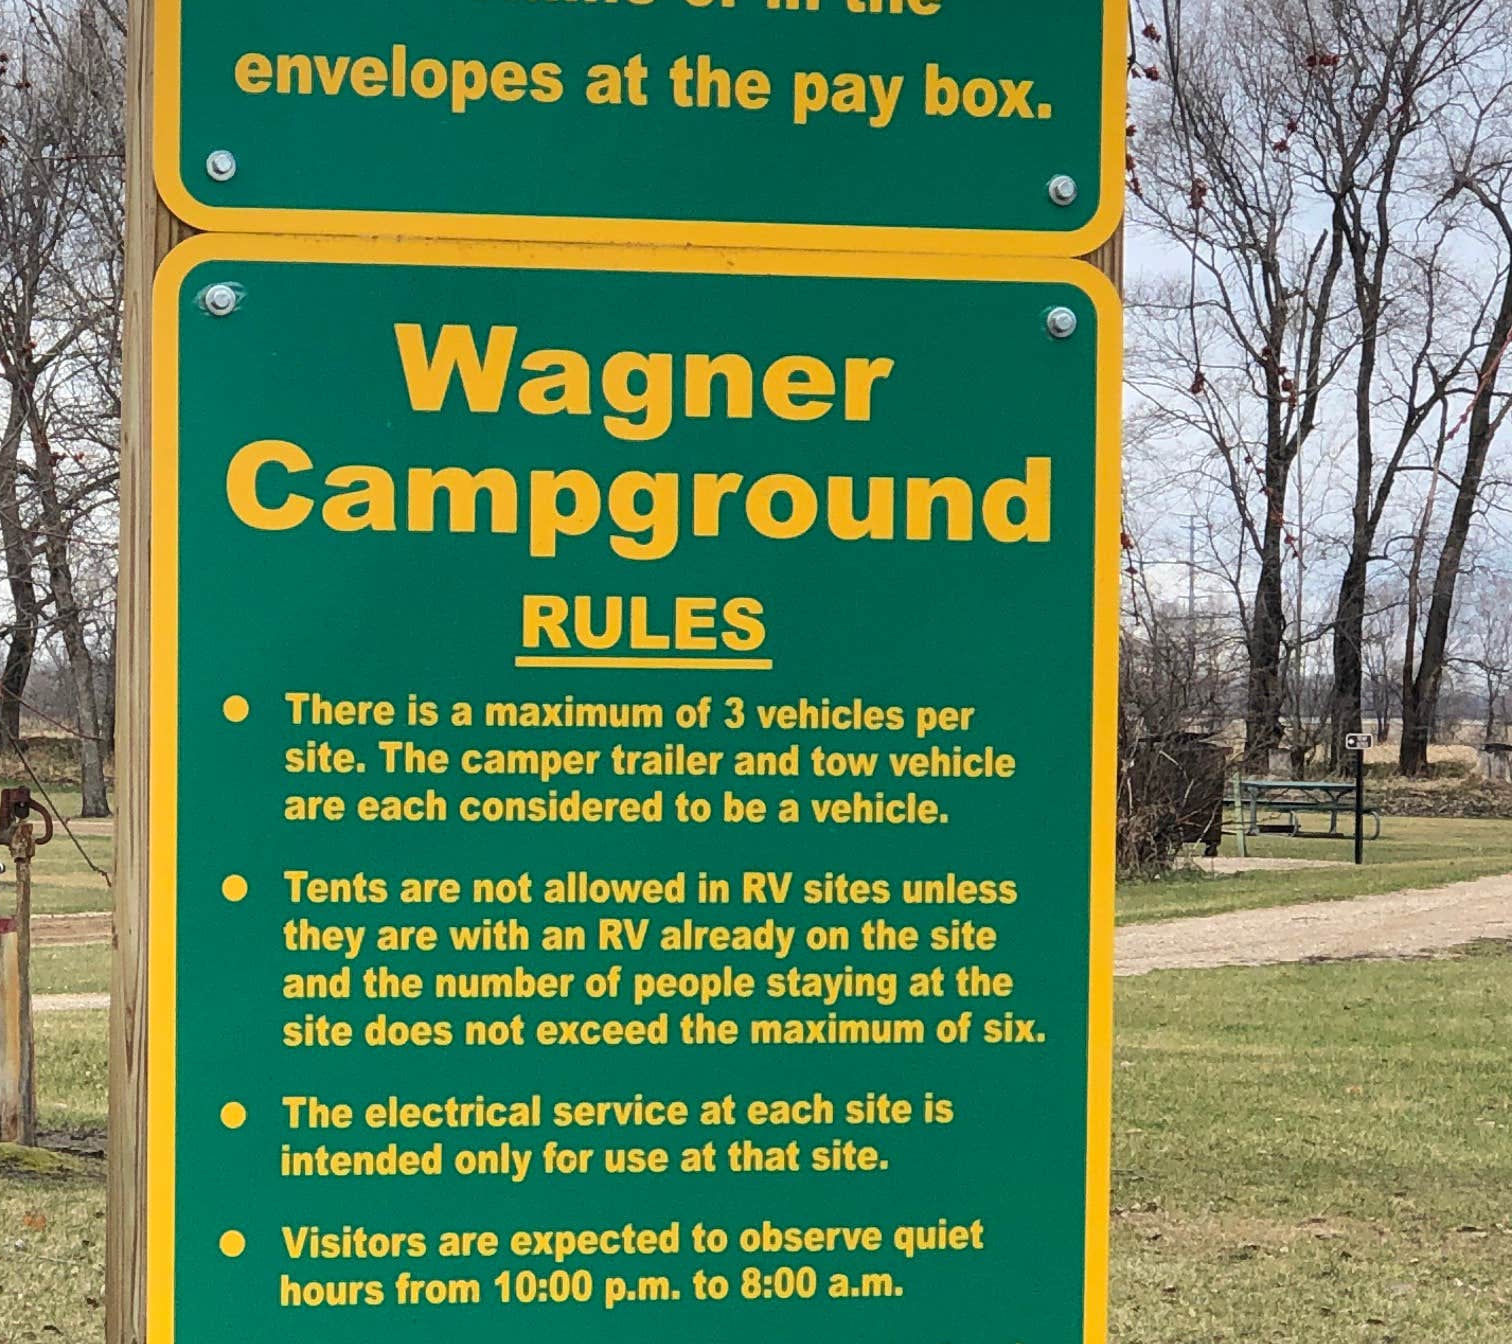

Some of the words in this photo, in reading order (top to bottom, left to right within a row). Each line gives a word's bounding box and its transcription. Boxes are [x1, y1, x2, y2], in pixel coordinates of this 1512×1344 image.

[235, 44, 563, 113] envelopes
[586, 55, 648, 106] at
[670, 55, 771, 109] the
[794, 72, 903, 128] pay
[925, 63, 1051, 118] box.
[395, 323, 894, 441] Wagner
[227, 440, 1051, 560] Campground
[521, 594, 767, 651] RULES
[286, 692, 394, 725] There
[408, 695, 438, 726] is
[452, 702, 472, 726] a
[486, 696, 663, 727] maximum
[676, 697, 711, 728] of
[726, 697, 744, 728] 3
[757, 699, 904, 730] vehicles
[917, 707, 973, 737] per
[286, 741, 364, 772] site.
[379, 741, 448, 773] The
[461, 750, 599, 781] camper
[612, 744, 722, 775] trailer
[735, 745, 799, 775] and
[811, 748, 877, 776] tow
[890, 747, 1015, 777] vehicle
[285, 797, 344, 820] are
[358, 790, 446, 820] each
[460, 791, 662, 822] considered
[676, 794, 711, 822] to
[724, 792, 766, 822] be
[779, 799, 799, 822] a
[812, 793, 947, 823] vehicle.
[284, 871, 387, 903] Tents
[401, 879, 460, 902] are
[473, 874, 531, 903] not
[545, 872, 685, 903] allowed
[699, 873, 729, 902] in
[743, 872, 791, 903] RV
[805, 873, 890, 903] sites
[903, 873, 1016, 904] unless
[284, 919, 364, 959] they
[378, 926, 437, 950] are
[450, 919, 529, 950] with
[542, 927, 585, 950] an
[599, 919, 648, 949] RV
[661, 919, 794, 958] already
[807, 927, 849, 950] on
[861, 920, 918, 950] the
[931, 920, 996, 950] site
[284, 967, 350, 998] and
[363, 967, 422, 998] the
[436, 967, 573, 997] number
[585, 965, 621, 997] of
[634, 966, 754, 1004] people
[767, 967, 897, 1005] staying
[910, 968, 944, 996] at
[956, 966, 1012, 996] the
[284, 1015, 352, 1046] site
[365, 1014, 452, 1046] does
[466, 1016, 523, 1045] not
[536, 1014, 668, 1044] exceed
[680, 1013, 738, 1044] the
[751, 1013, 924, 1043] maximum
[937, 1012, 971, 1043] of
[984, 1012, 1044, 1043] six.
[283, 1096, 352, 1128] The
[366, 1095, 540, 1127] electrical
[555, 1095, 688, 1126] service
[701, 1096, 735, 1124] at
[747, 1093, 833, 1124] each
[847, 1094, 911, 1124] site
[925, 1093, 953, 1124] is
[281, 1143, 442, 1175] intended
[455, 1143, 531, 1182] only
[543, 1142, 592, 1173] for
[605, 1149, 668, 1172] use
[681, 1143, 715, 1172] at
[728, 1141, 799, 1171] that
[813, 1140, 887, 1171] site.
[283, 1227, 426, 1258] Visitors
[440, 1232, 498, 1256] are
[511, 1222, 679, 1262] expected
[692, 1224, 727, 1252] to
[740, 1221, 882, 1252] observe
[894, 1219, 983, 1257] quiet
[281, 1275, 384, 1305] hours
[396, 1272, 480, 1303] from
[495, 1270, 592, 1302] 10:00
[605, 1277, 679, 1308] p.m.
[693, 1271, 728, 1299] to
[741, 1266, 816, 1299] 8:00
[829, 1274, 903, 1297] a.m.
